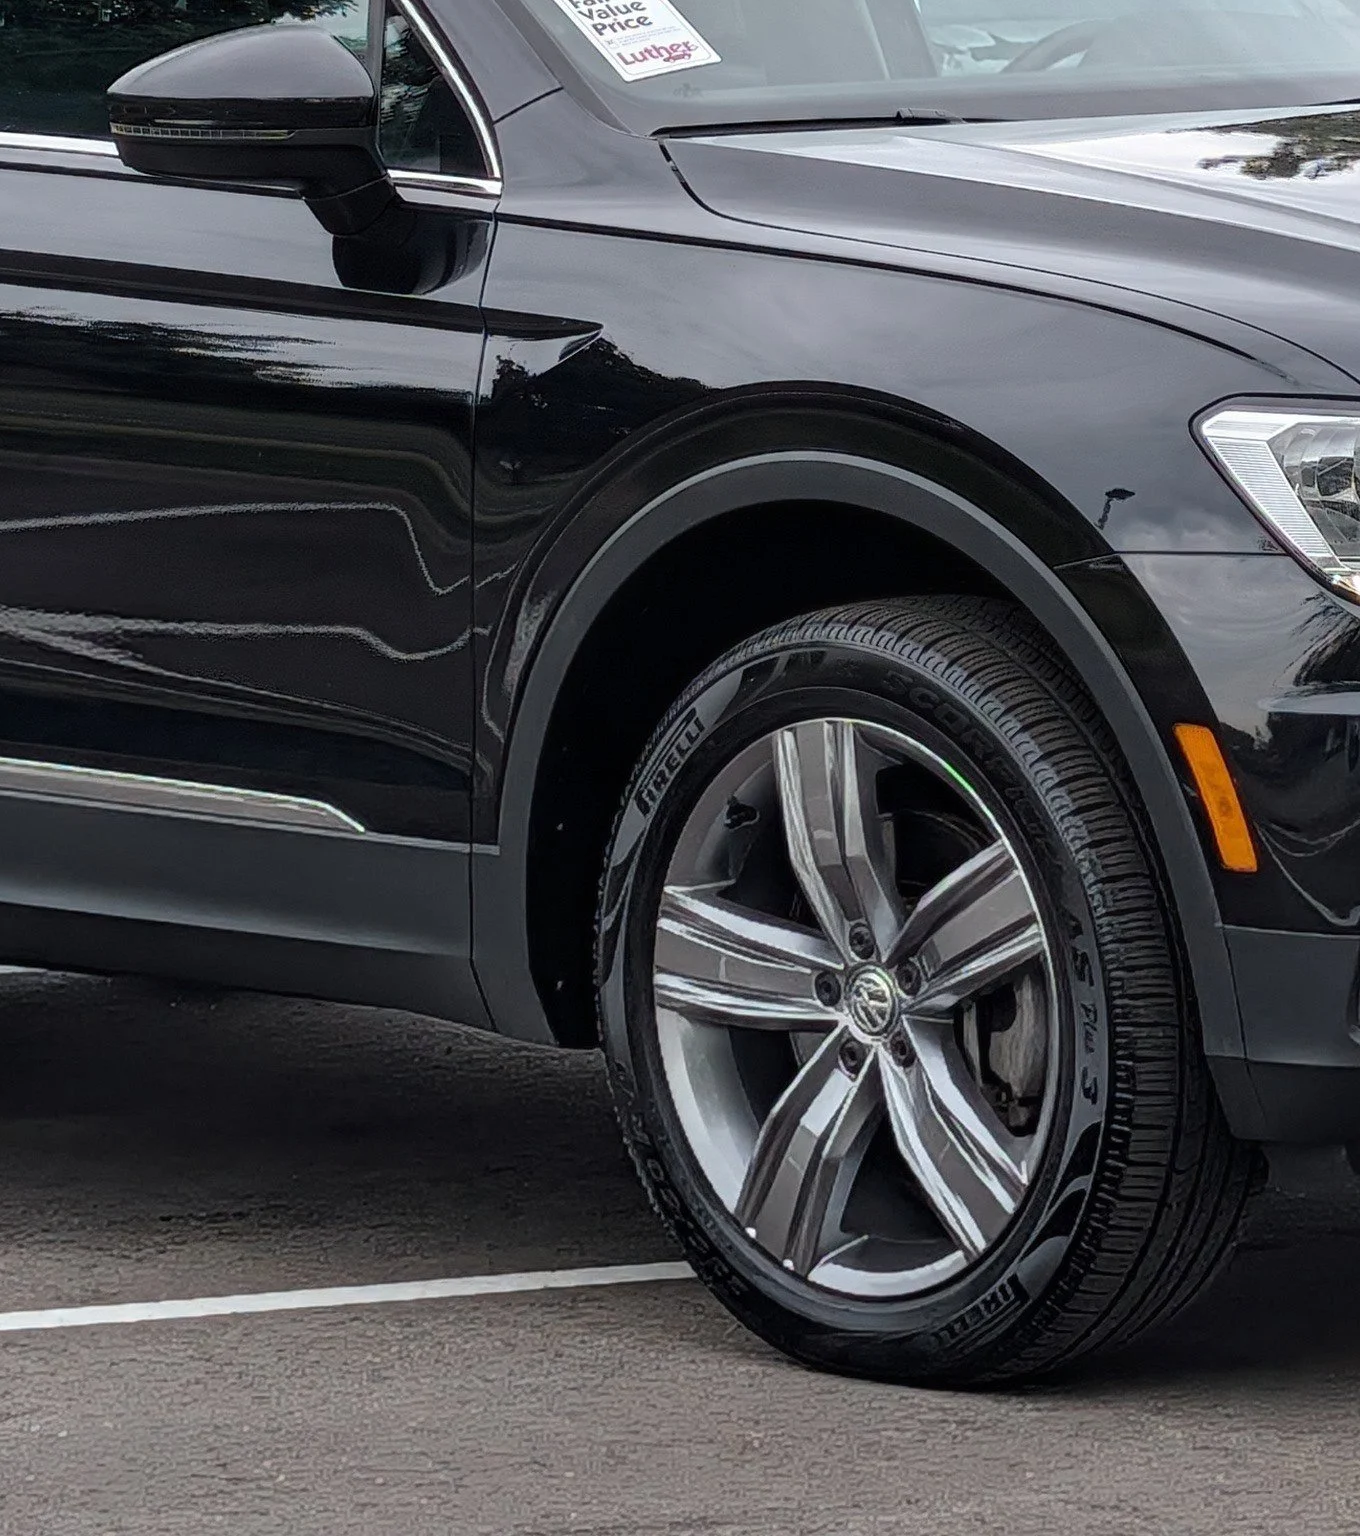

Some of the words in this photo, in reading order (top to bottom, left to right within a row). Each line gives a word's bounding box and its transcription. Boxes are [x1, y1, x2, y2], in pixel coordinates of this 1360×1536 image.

[577, 1, 647, 21] Value
[592, 15, 653, 36] Price
[616, 41, 691, 66] Luther
[634, 707, 705, 815] PIRELLI
